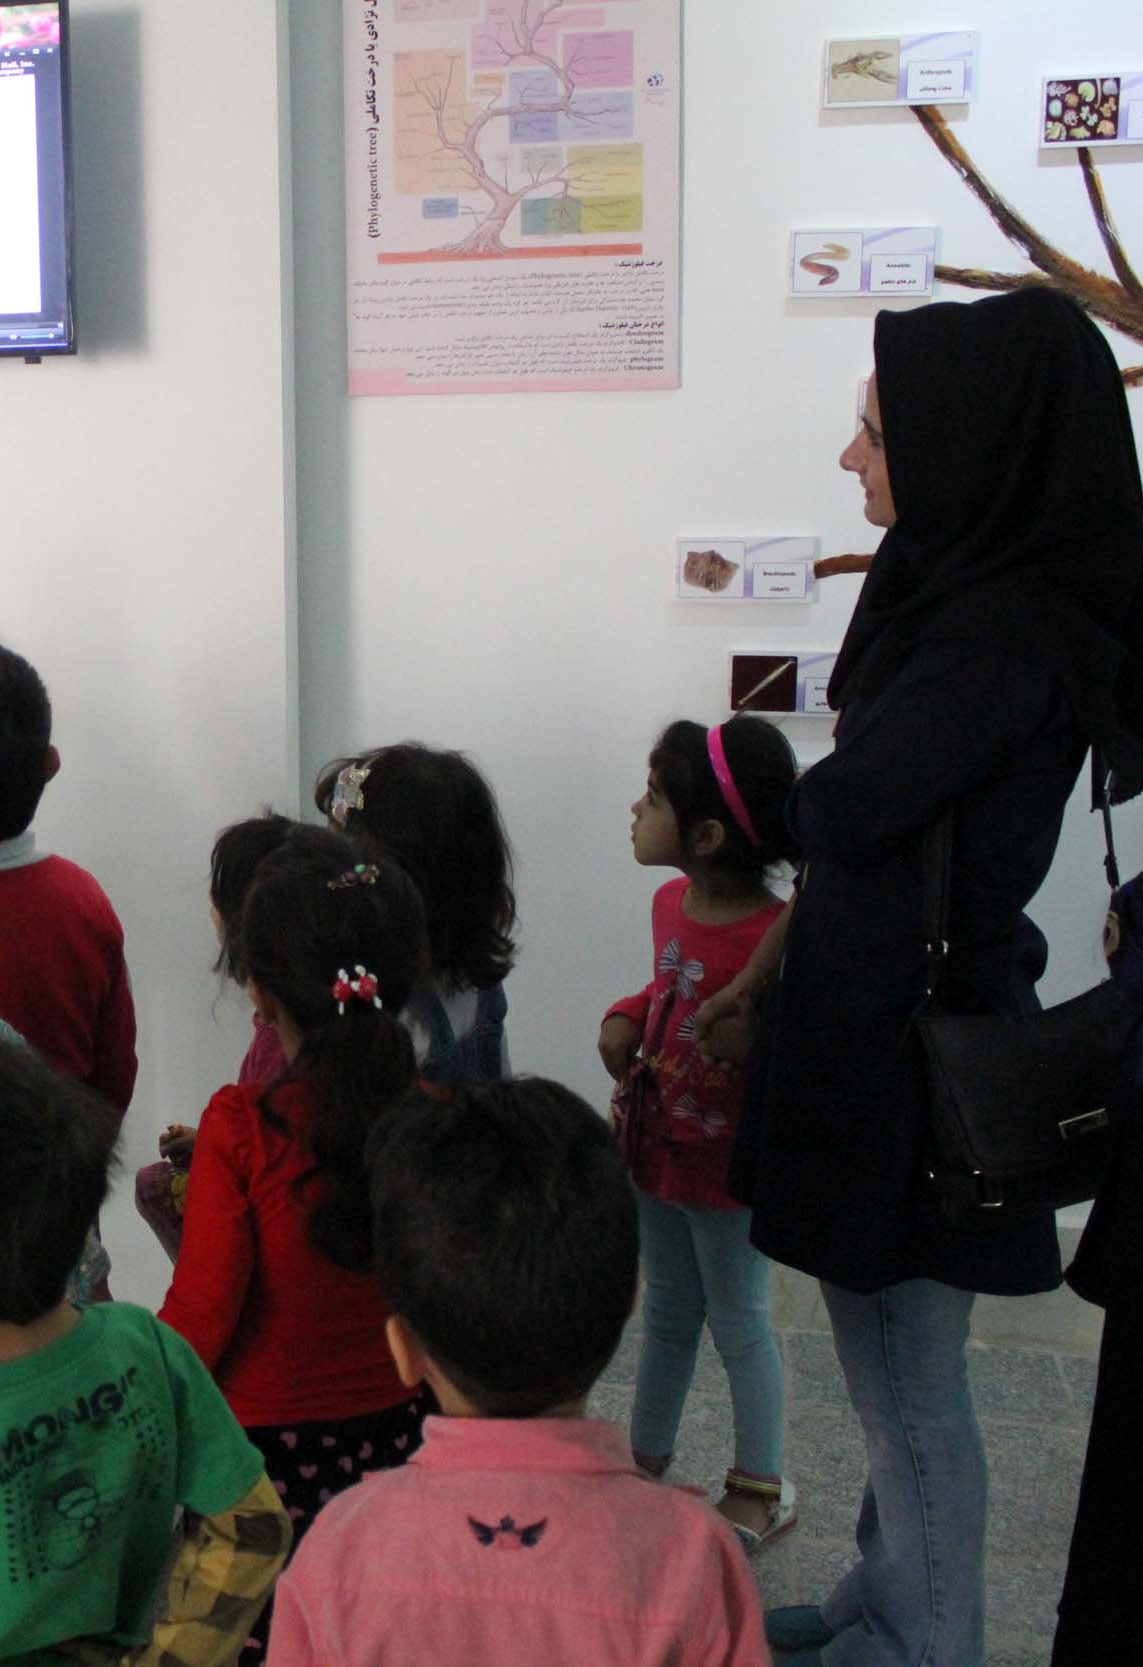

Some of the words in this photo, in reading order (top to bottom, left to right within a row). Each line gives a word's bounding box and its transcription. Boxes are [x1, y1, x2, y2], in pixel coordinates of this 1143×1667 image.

[20, 60, 35, 68] Inc.
[365, 54, 379, 87] درخت
[365, 90, 380, 124] تکاملی
[366, 127, 380, 156] tree)
[366, 158, 382, 238] (Phylogenetic
